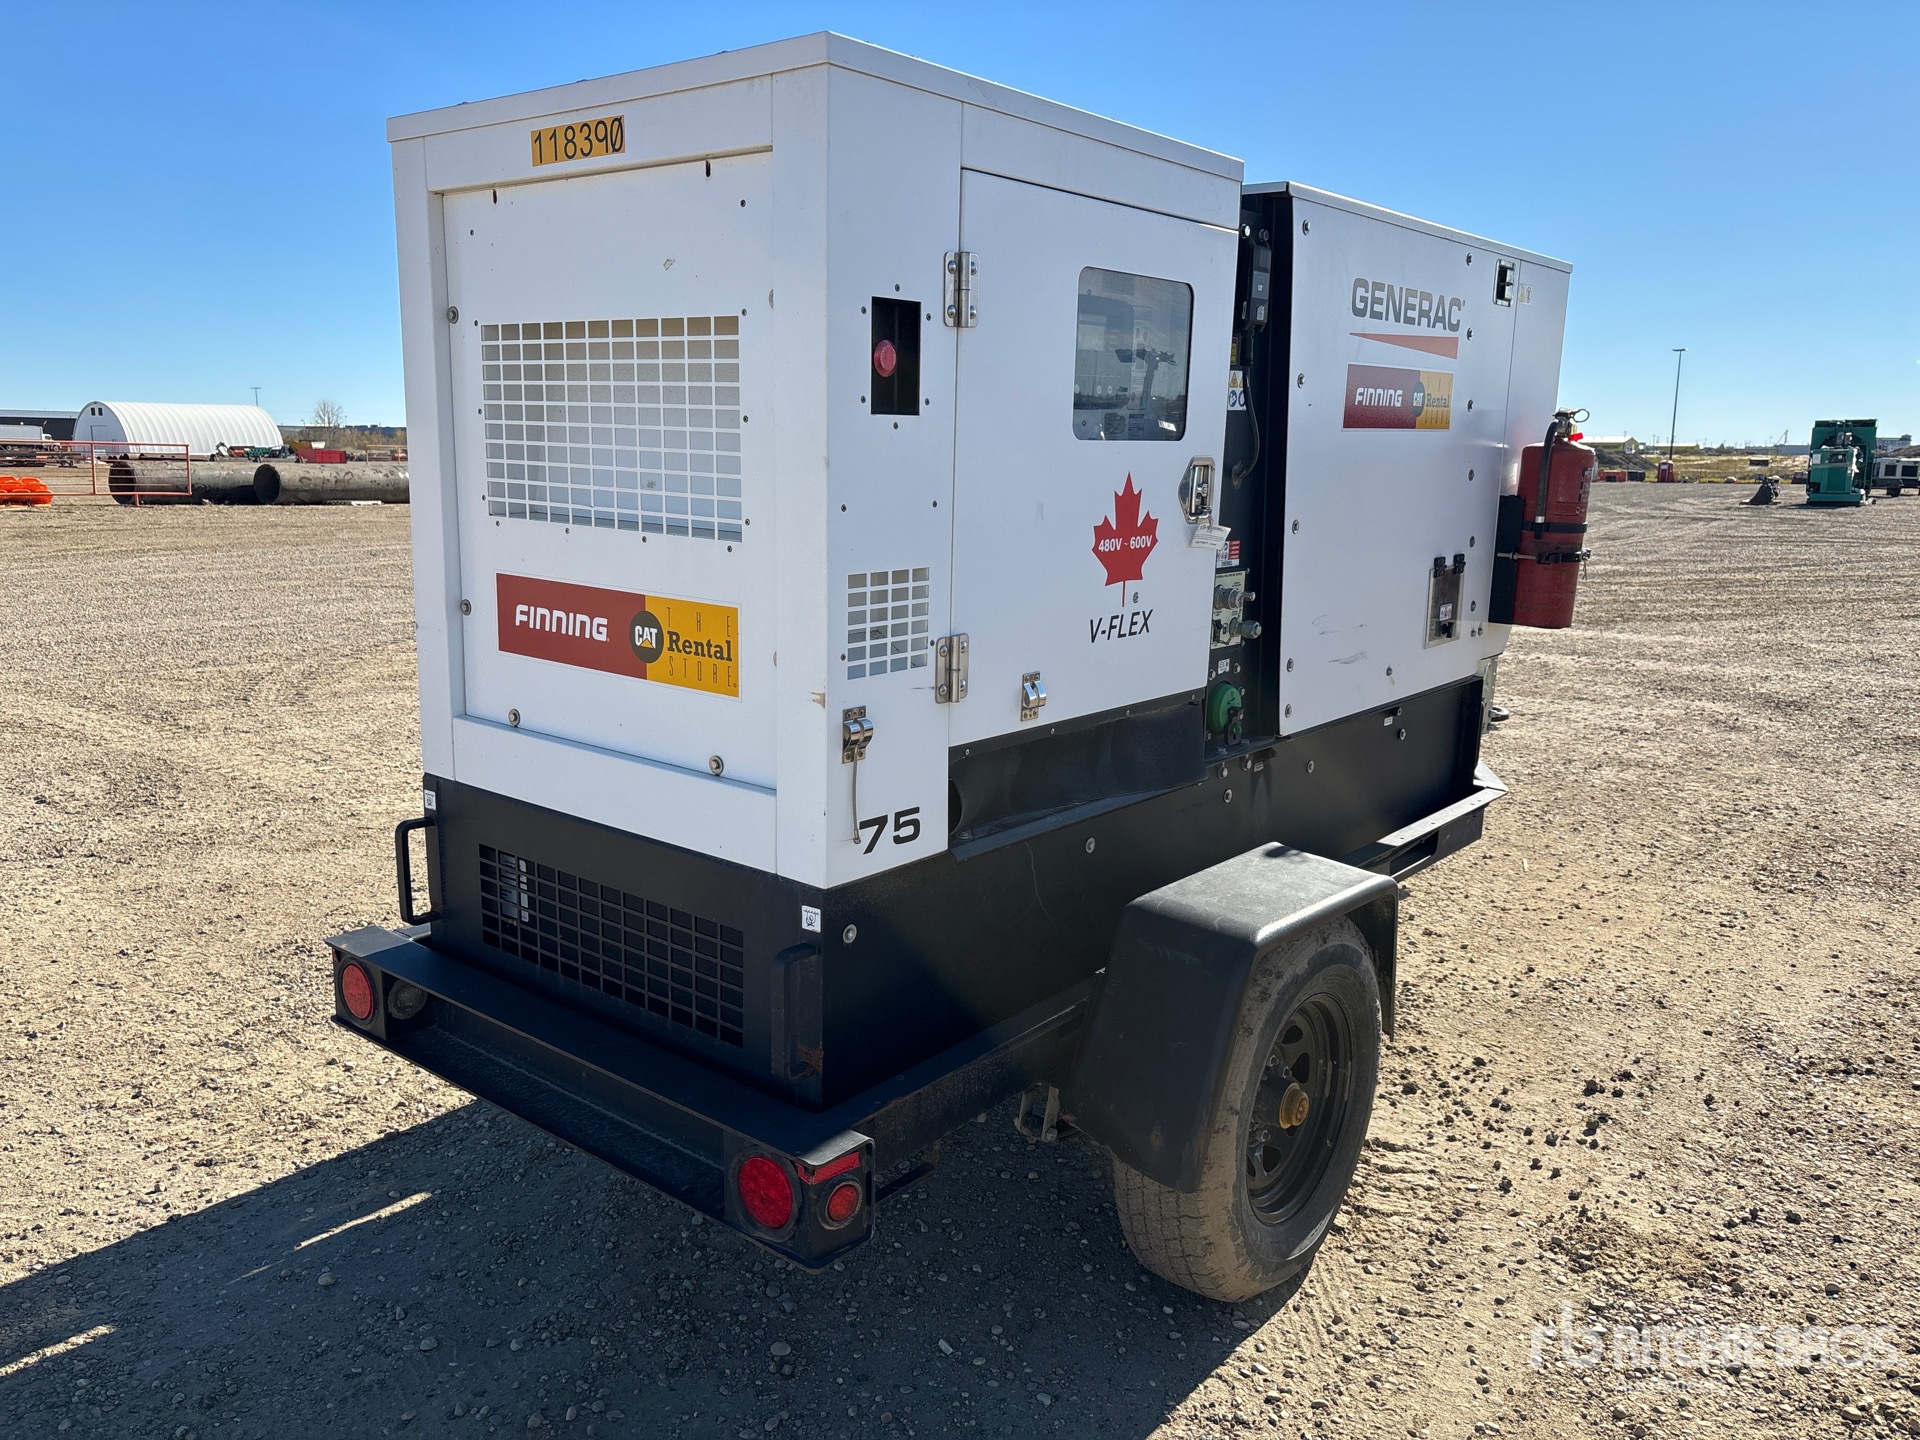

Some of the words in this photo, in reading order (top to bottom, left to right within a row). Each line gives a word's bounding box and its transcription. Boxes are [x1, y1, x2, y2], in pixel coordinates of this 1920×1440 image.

[534, 117, 624, 164] 118390
[1351, 277, 1462, 332] GENERAC
[1354, 387, 1403, 408] FINNING
[1412, 391, 1424, 407] CAT
[1426, 392, 1450, 409] Rental
[1098, 537, 1123, 553] 480V
[1129, 535, 1153, 550] 600V
[515, 603, 609, 642] FINNING
[634, 625, 658, 649] CAT
[667, 630, 733, 662] Rental
[666, 606, 732, 637] THE
[1089, 609, 1154, 644] V-FLEX
[668, 656, 732, 687] STORE
[858, 806, 921, 856] 75
